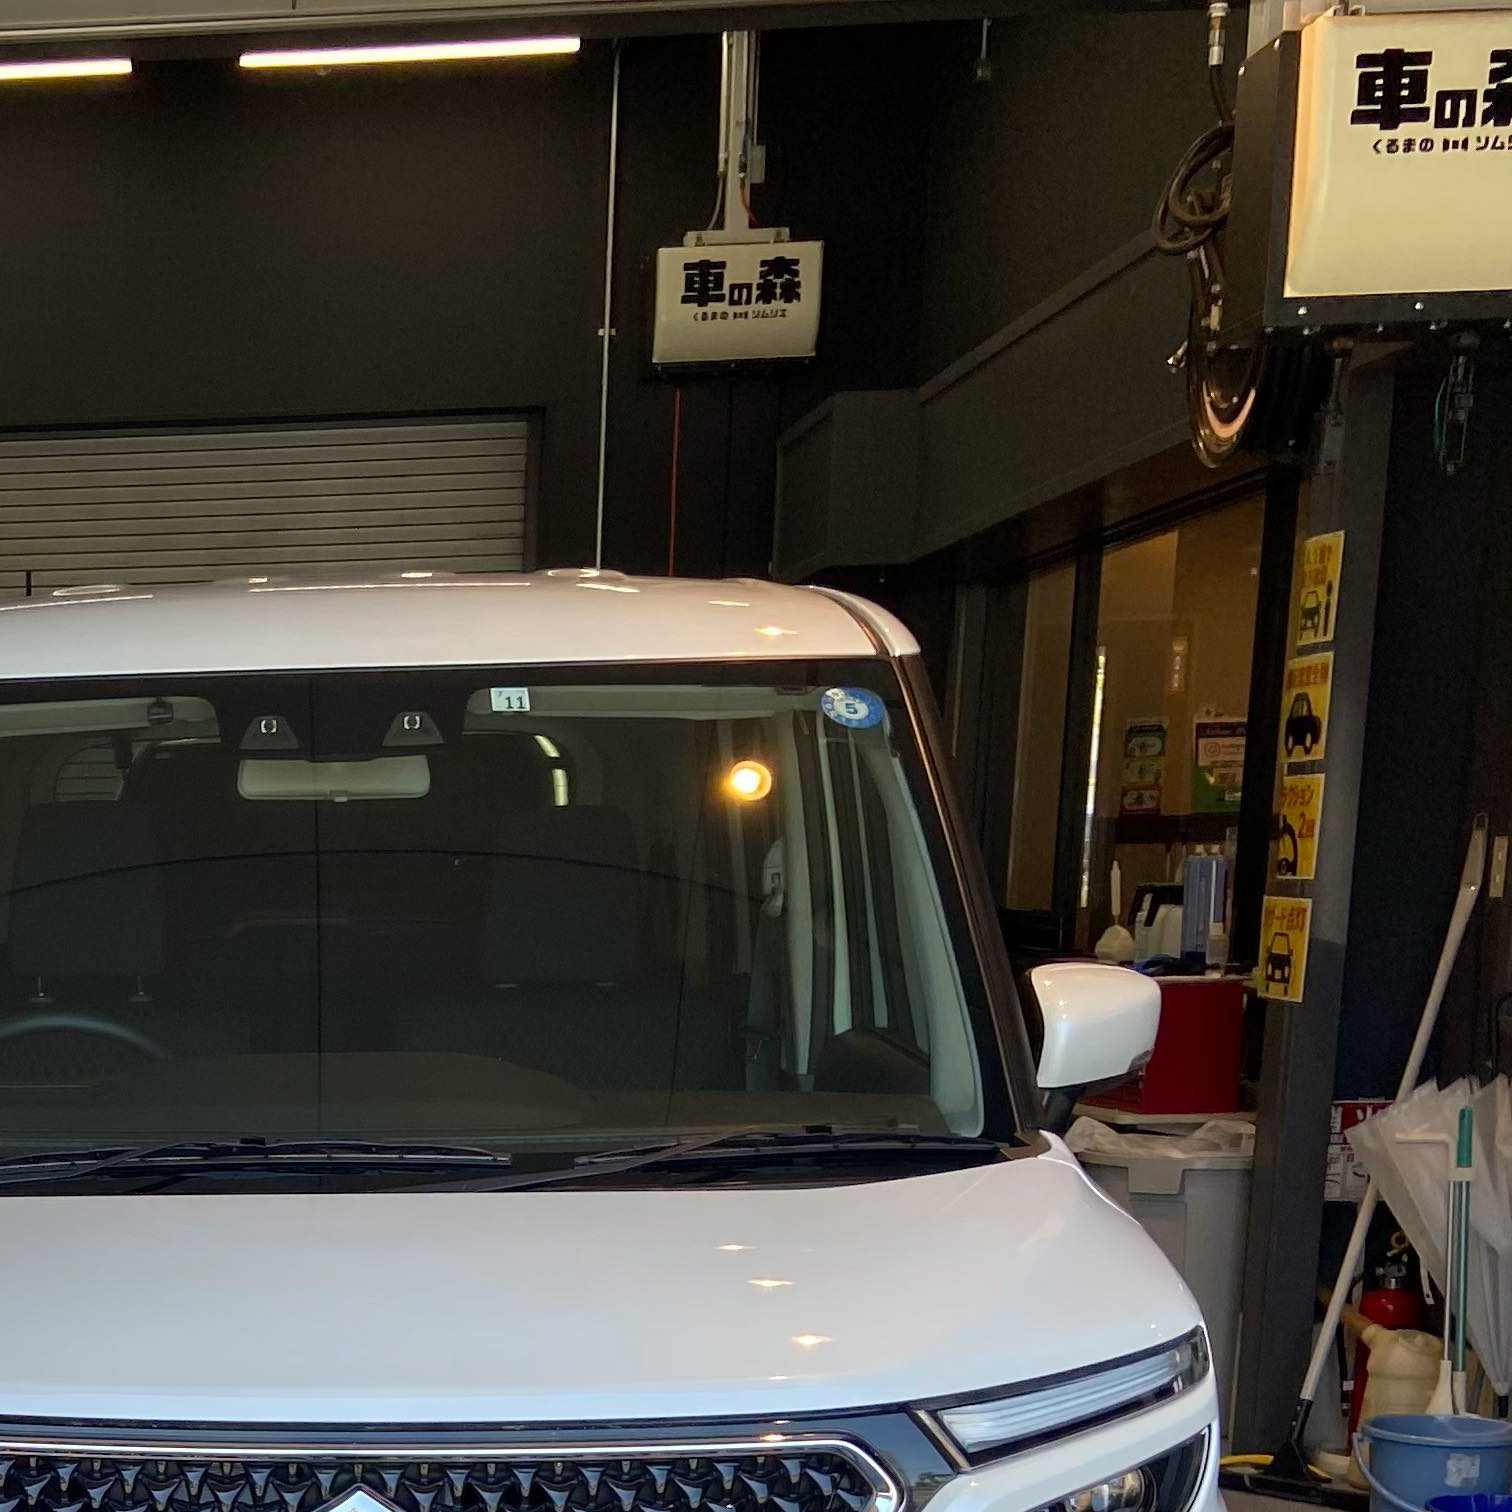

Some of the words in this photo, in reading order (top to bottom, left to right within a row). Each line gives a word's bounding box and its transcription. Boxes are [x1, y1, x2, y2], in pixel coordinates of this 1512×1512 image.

[1372, 137, 1435, 154] くるまの
[1476, 135, 1512, 152] ソム
[680, 255, 802, 307] 車の森
[505, 696, 526, 709] 11
[845, 702, 858, 715] 5
